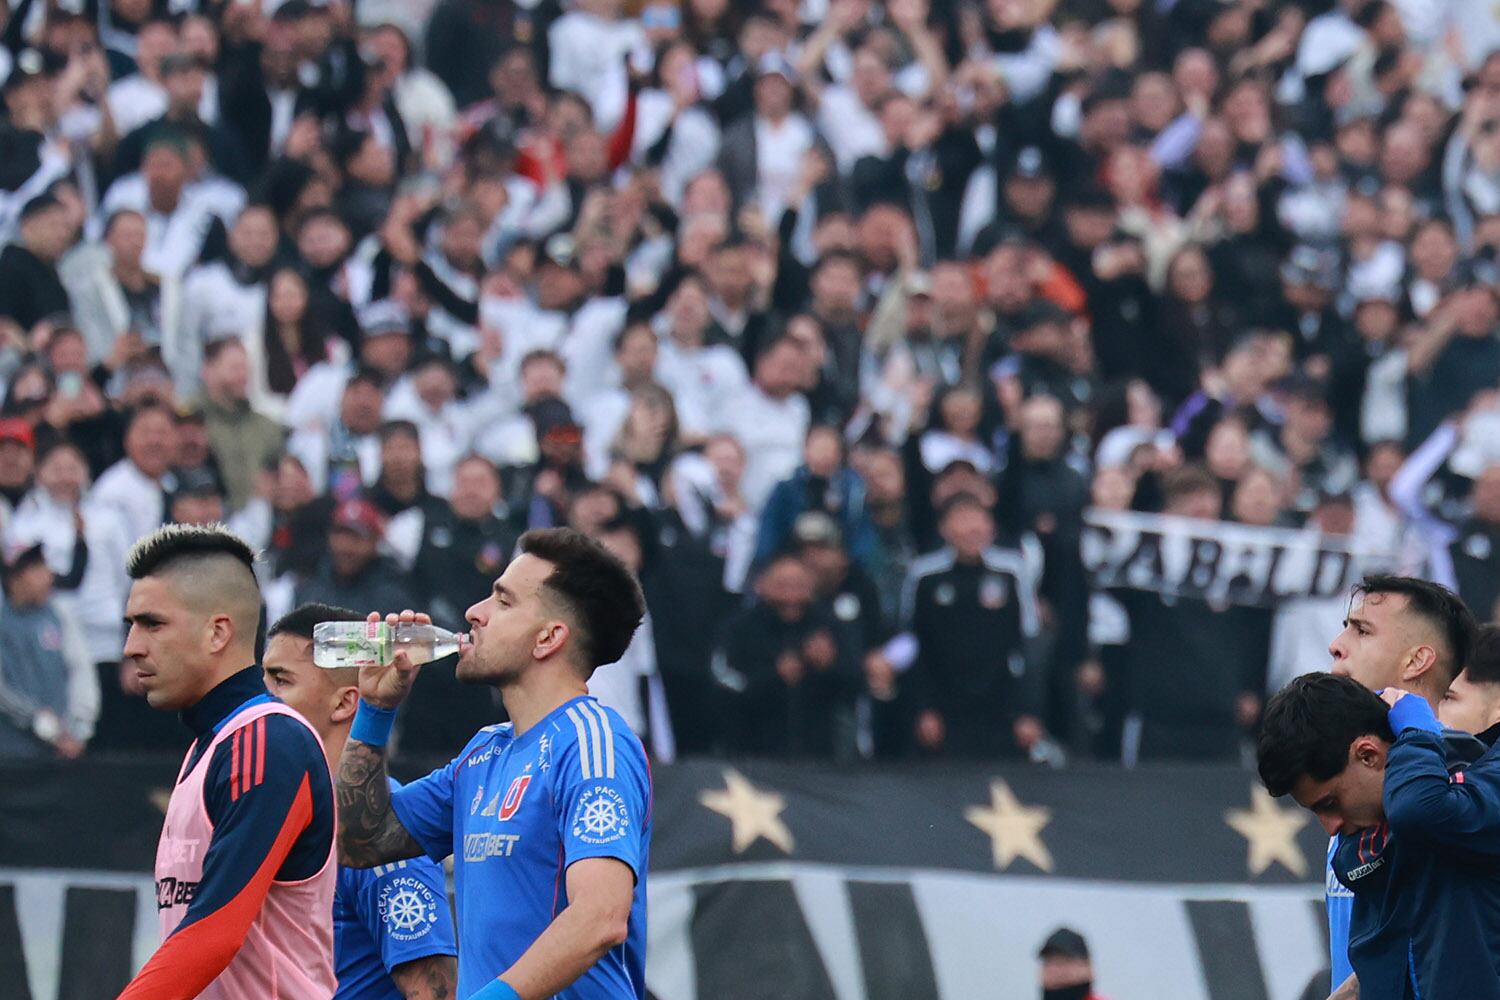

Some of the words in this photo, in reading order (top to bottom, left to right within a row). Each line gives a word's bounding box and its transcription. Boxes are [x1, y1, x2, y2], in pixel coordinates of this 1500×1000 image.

[498, 775, 532, 821] U
[378, 884, 392, 923] OCEAN
[392, 877, 436, 911] PACIFIC'S
